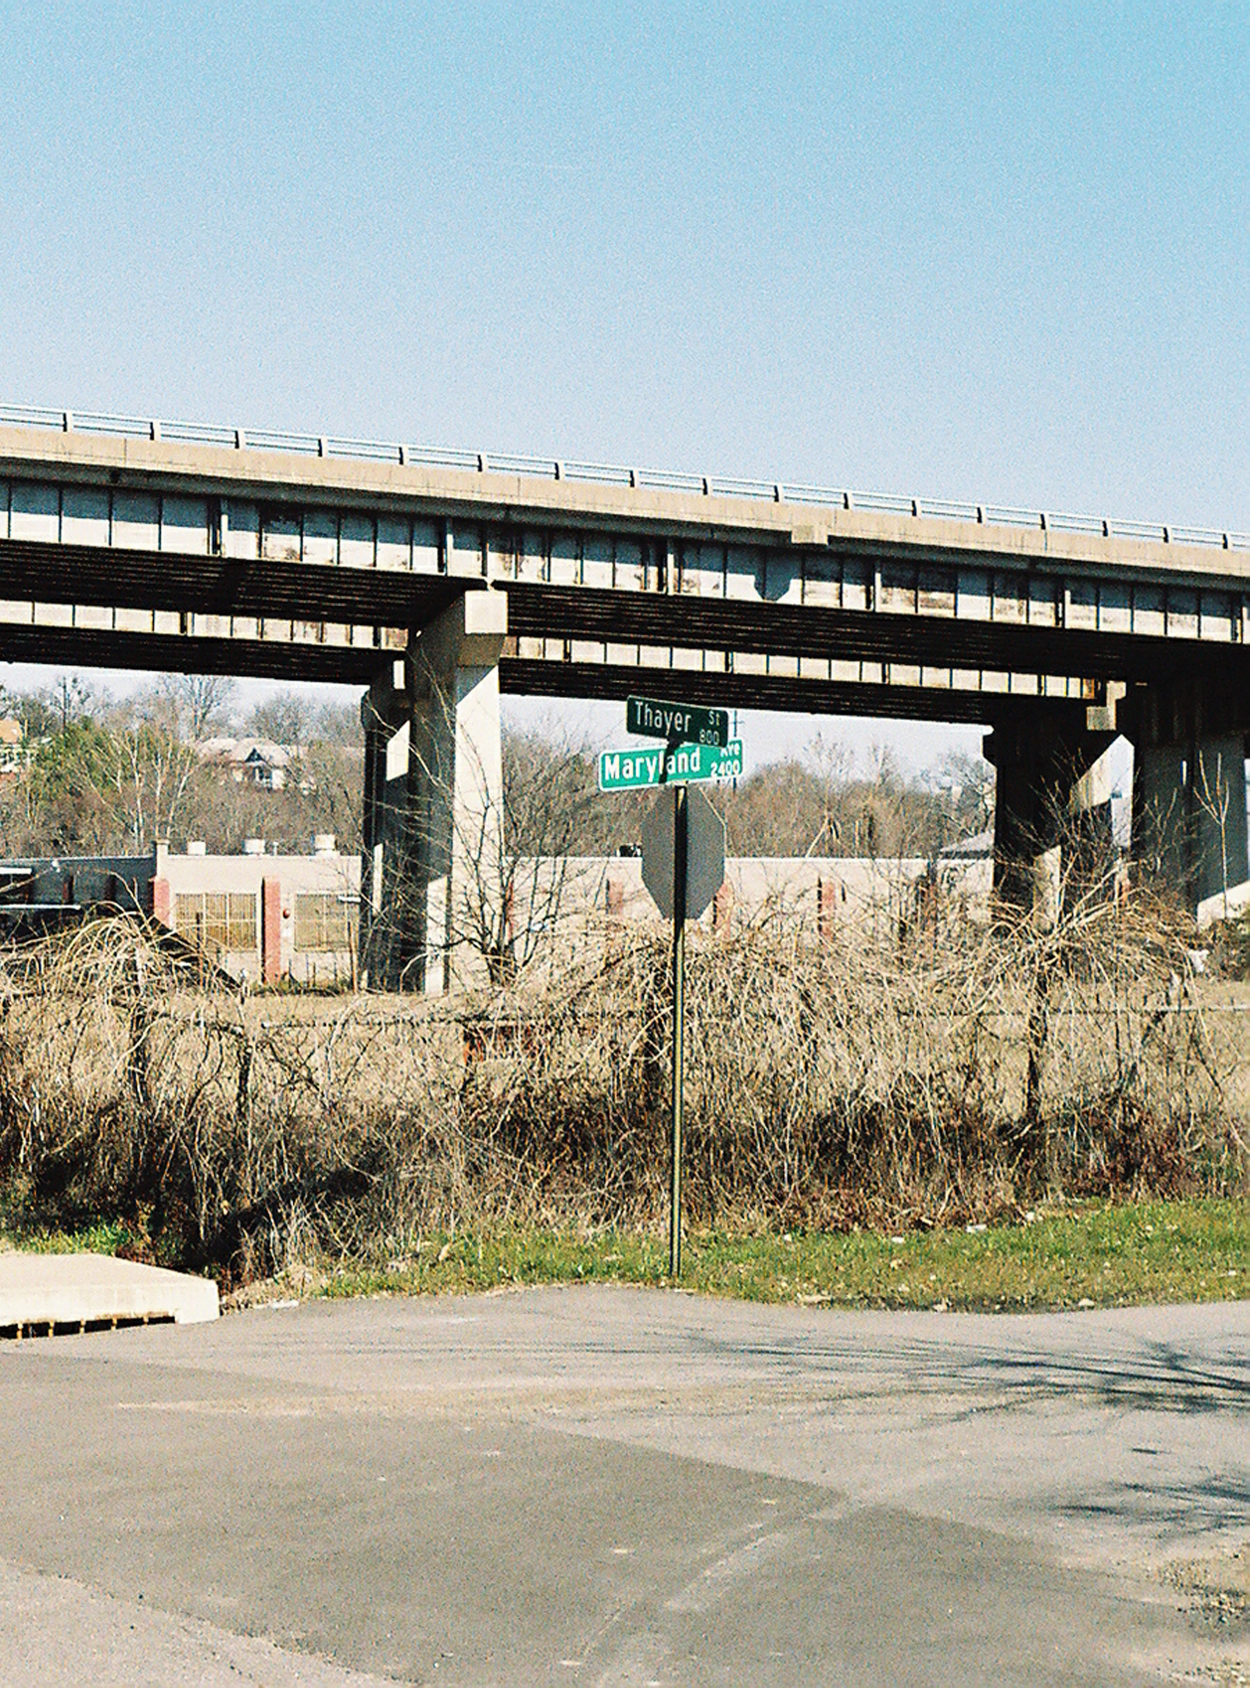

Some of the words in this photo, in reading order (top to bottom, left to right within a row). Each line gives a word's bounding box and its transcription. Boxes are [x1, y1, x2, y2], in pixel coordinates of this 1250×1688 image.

[635, 701, 692, 736] Thayer
[708, 710, 721, 726] St
[699, 729, 720, 746] 800
[604, 746, 701, 783] Maryland
[710, 759, 741, 778] 2400
